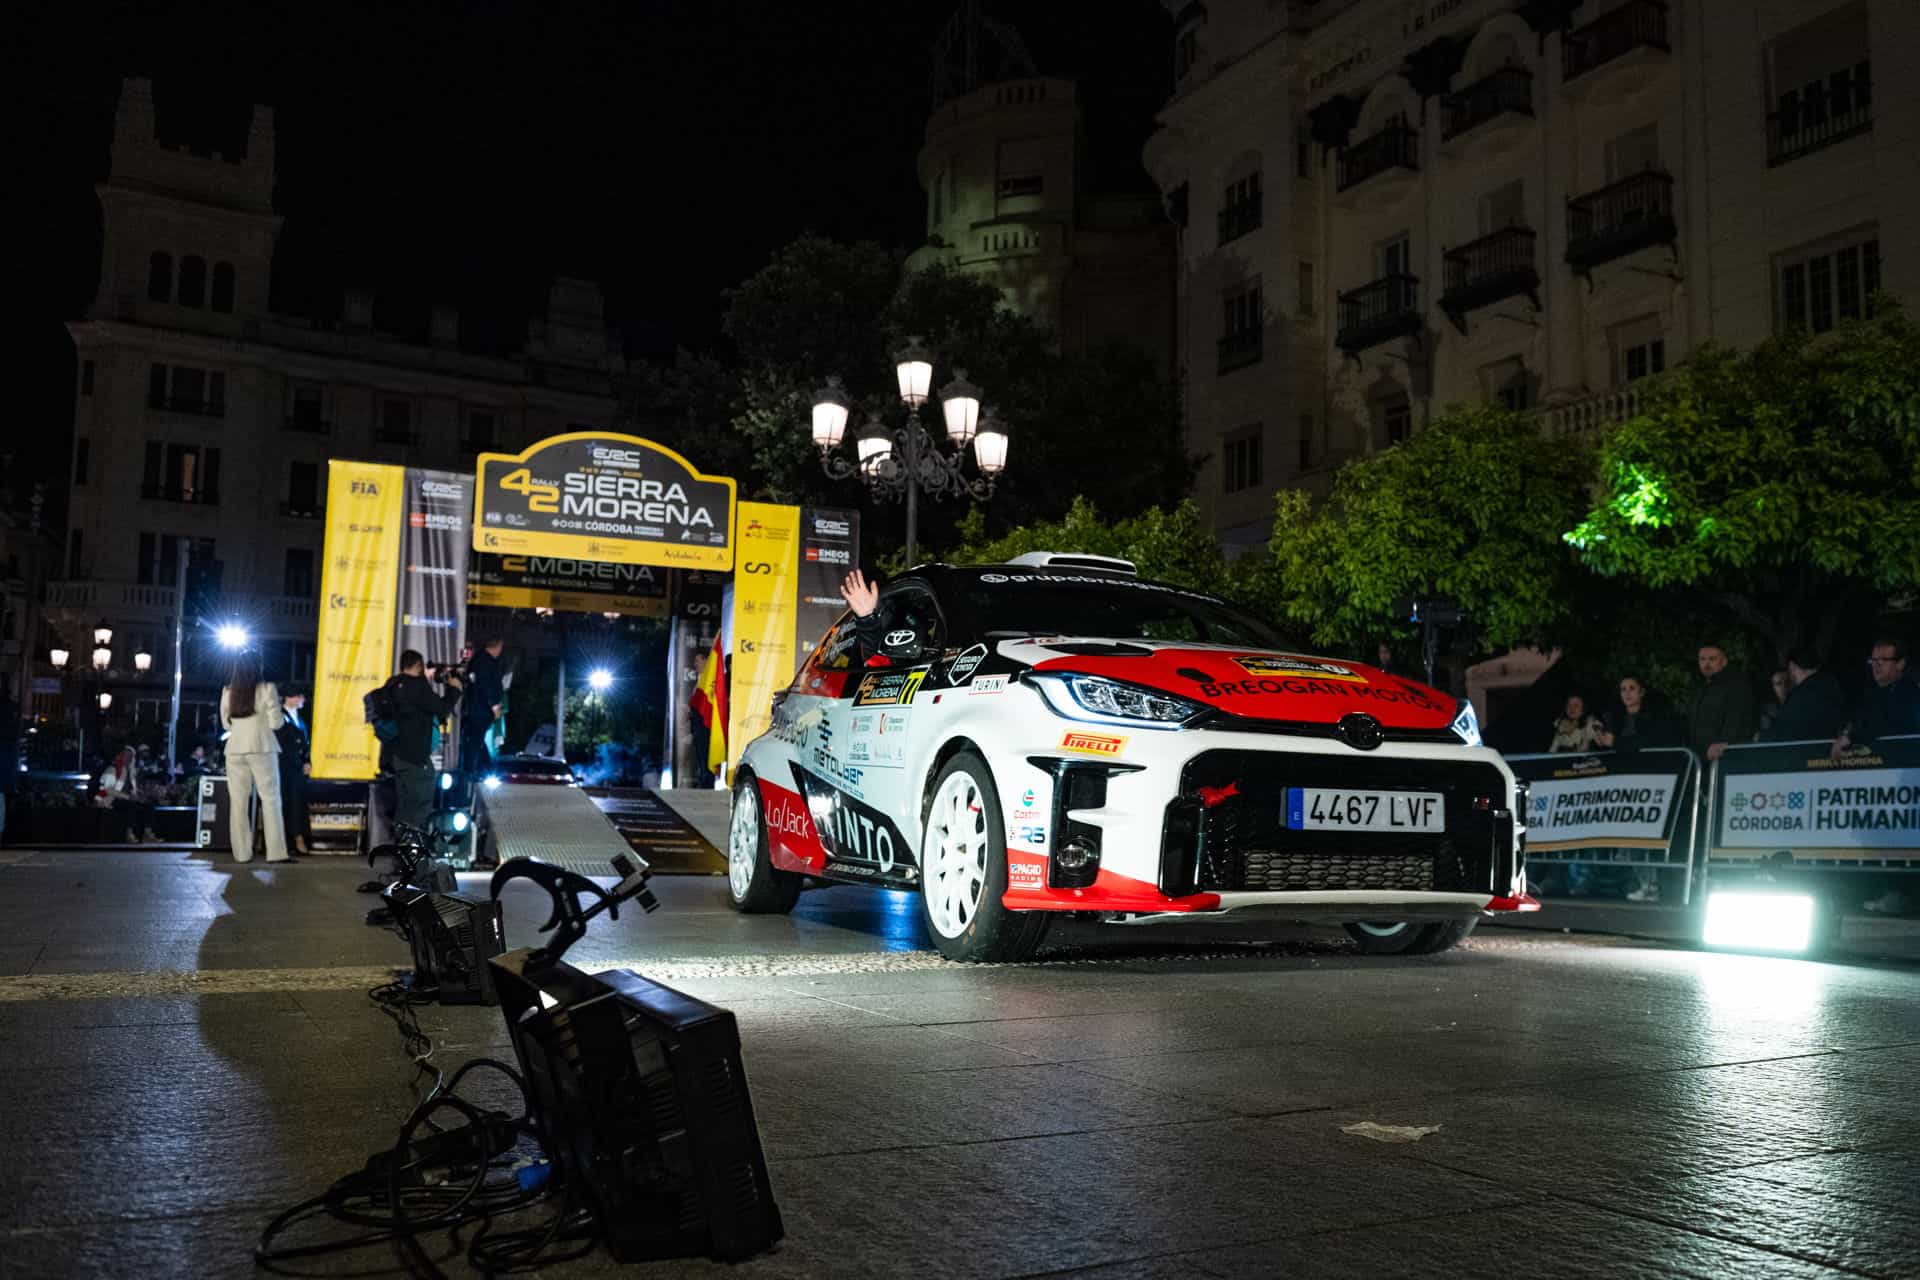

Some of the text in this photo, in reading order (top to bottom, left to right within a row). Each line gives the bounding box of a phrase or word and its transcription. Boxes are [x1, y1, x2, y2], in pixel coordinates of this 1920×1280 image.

[593, 448, 640, 462] ERC
[351, 481, 378, 495] FIA
[564, 472, 688, 503] SIERRA
[563, 494, 714, 528] MORENA
[585, 520, 633, 534] CÓRDOBA
[818, 549, 850, 560] ENEOS
[530, 557, 655, 583] MORENA
[1200, 679, 1348, 698] BREOGAN
[1062, 733, 1122, 752] PIRELLI
[1556, 788, 1650, 809] PATRIMONIO
[1294, 794, 1437, 826] E 4467 LVF
[1552, 806, 1661, 828] HUMANIDAD
[1816, 809, 1920, 830] HUMANI
[1729, 815, 1804, 831] CÓRDOBA
